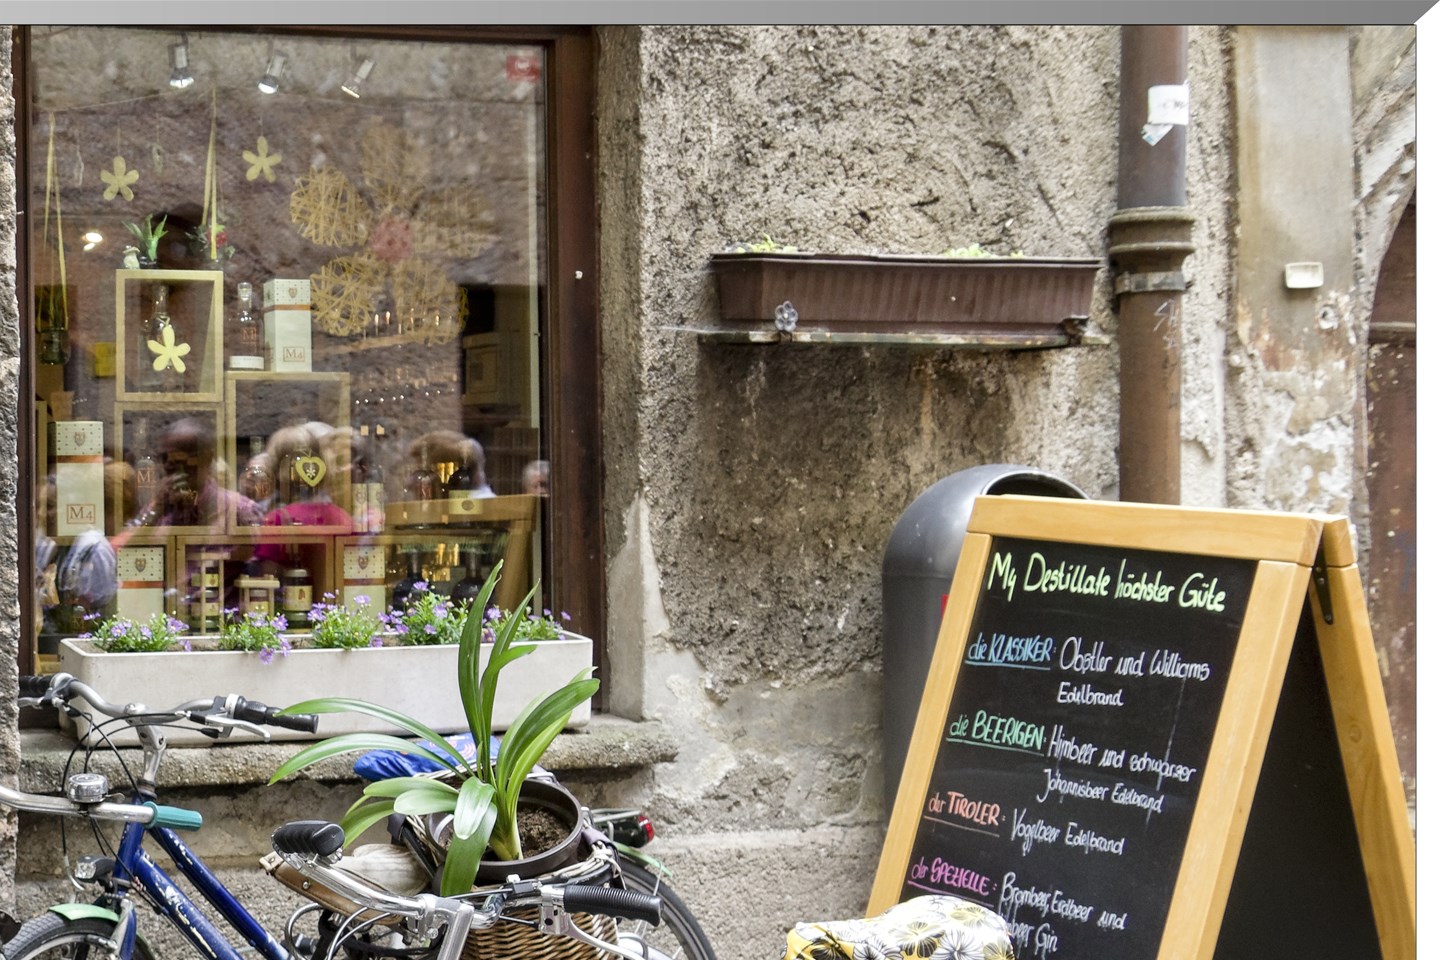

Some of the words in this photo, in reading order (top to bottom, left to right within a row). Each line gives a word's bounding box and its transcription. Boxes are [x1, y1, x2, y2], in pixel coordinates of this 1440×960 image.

[986, 551, 1017, 602] My
[1022, 551, 1111, 597] Destillate
[1113, 557, 1176, 603] höchster
[1178, 571, 1227, 612] Güte
[967, 631, 988, 660] die
[1059, 636, 1112, 674] Obstler
[1114, 651, 1145, 677] und
[1149, 649, 1211, 682] Williams
[1056, 681, 1124, 706] Edelbrand
[949, 713, 969, 737] die
[1047, 724, 1098, 766] Himbeer
[1098, 748, 1126, 769] und
[1036, 768, 1110, 803] Johannisbeer
[1111, 782, 1165, 814] Edelbrand
[928, 791, 947, 814] der
[1064, 821, 1125, 856] Edelbrand
[911, 855, 929, 880] der
[1050, 890, 1094, 922] Erdbeer
[1097, 910, 1128, 931] und
[1006, 918, 1036, 945] beer
[1034, 922, 1059, 951] Gin
